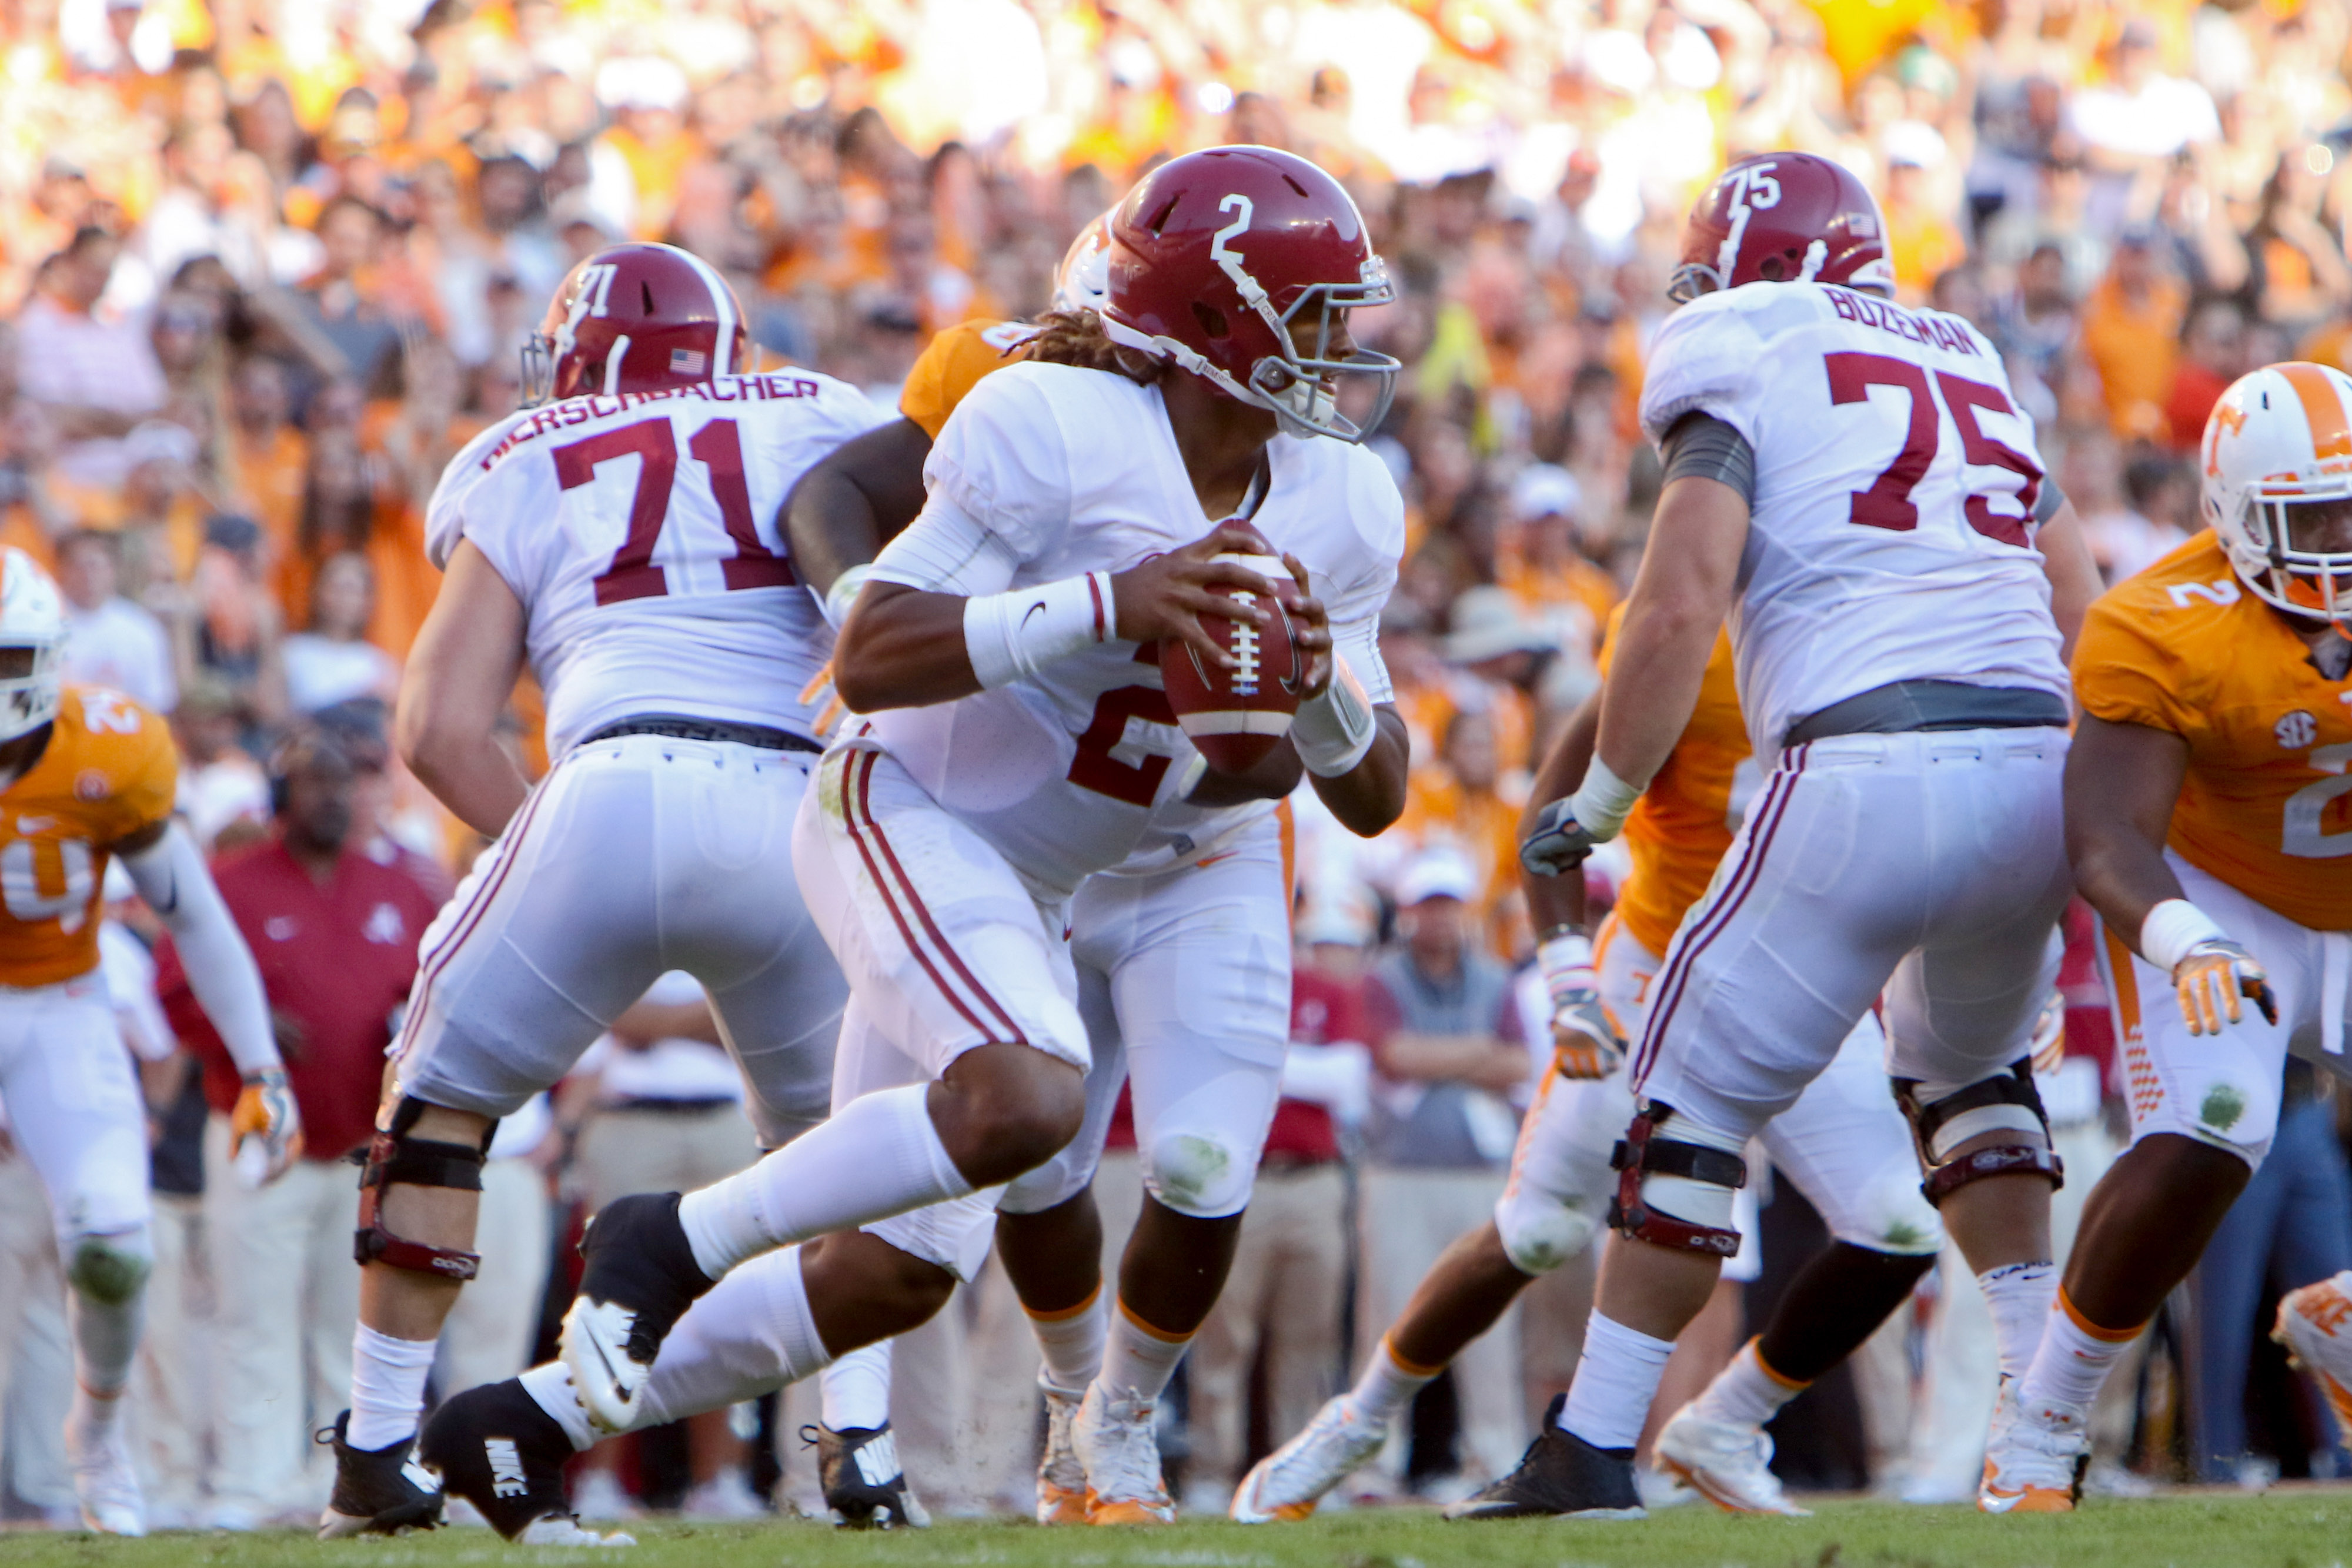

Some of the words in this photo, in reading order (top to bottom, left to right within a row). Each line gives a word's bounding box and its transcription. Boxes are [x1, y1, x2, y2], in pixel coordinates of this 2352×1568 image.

[1720, 161, 1782, 220] 75
[1210, 193, 1254, 266] 2
[1823, 350, 2045, 550] 75
[550, 416, 796, 607] 71
[2166, 579, 2242, 609] 2
[483, 1437, 529, 1499] NIKE
